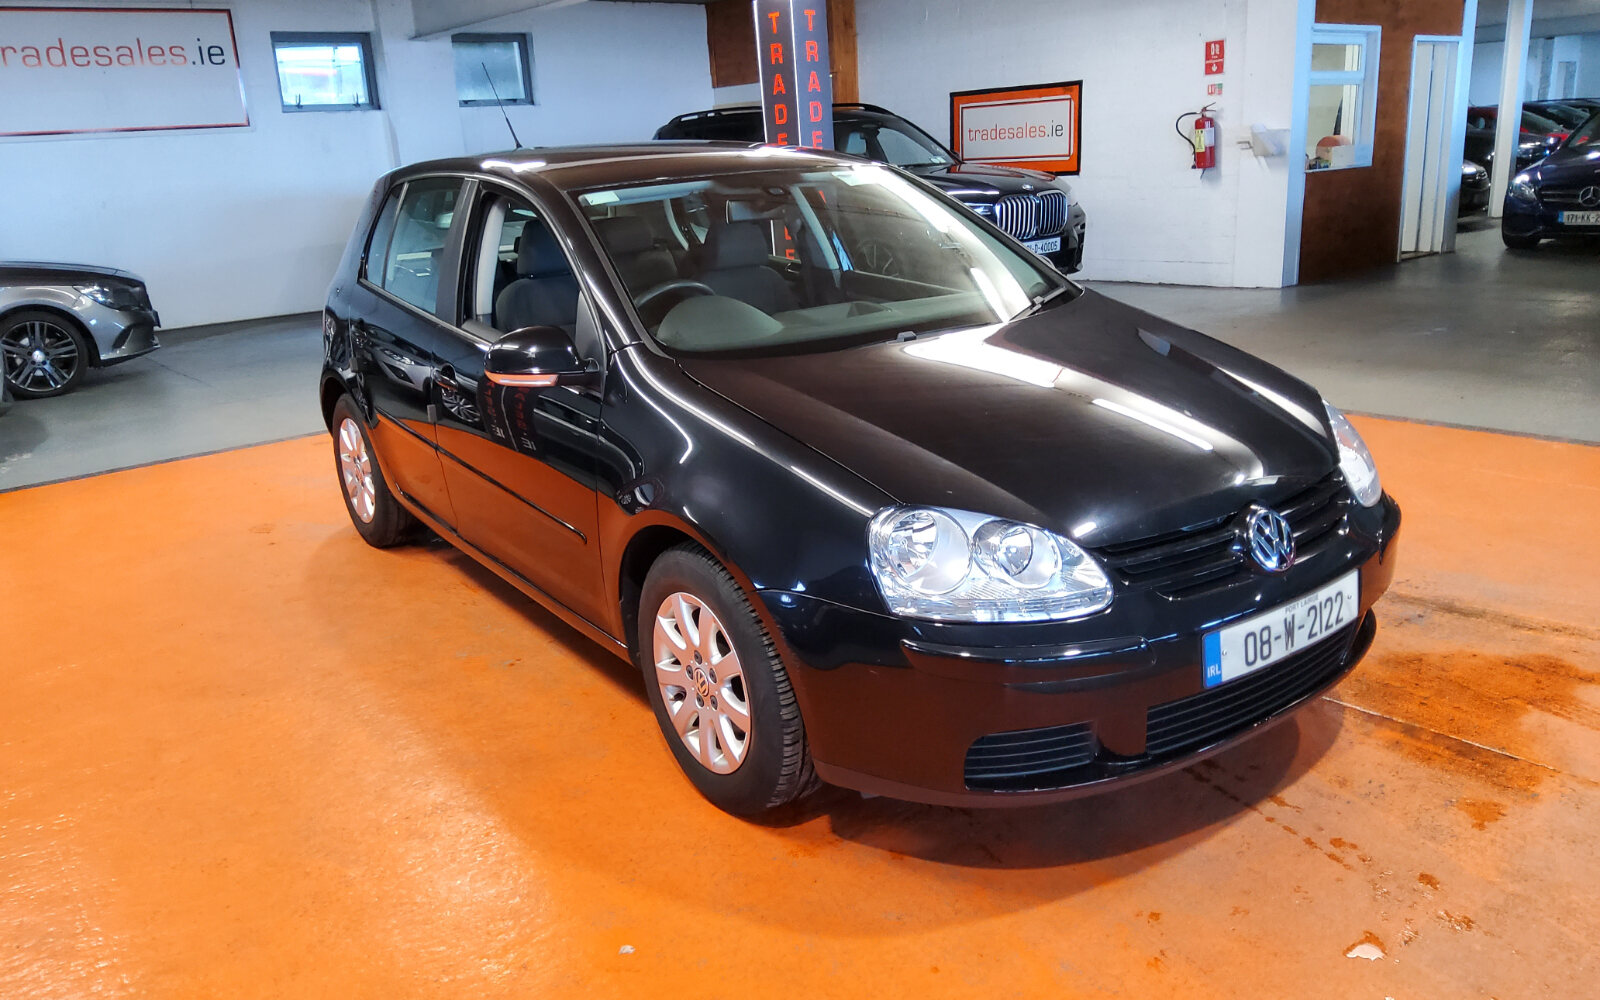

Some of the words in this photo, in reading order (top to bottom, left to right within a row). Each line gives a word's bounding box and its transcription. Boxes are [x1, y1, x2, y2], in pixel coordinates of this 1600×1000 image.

[0, 37, 226, 68] radesales.ie
[768, 11, 788, 146] TRADE
[804, 9, 823, 150] TRADE
[968, 119, 1064, 142] tradesales.ie
[1244, 591, 1344, 667] 08-W-2122
[1207, 663, 1221, 678] IRL
